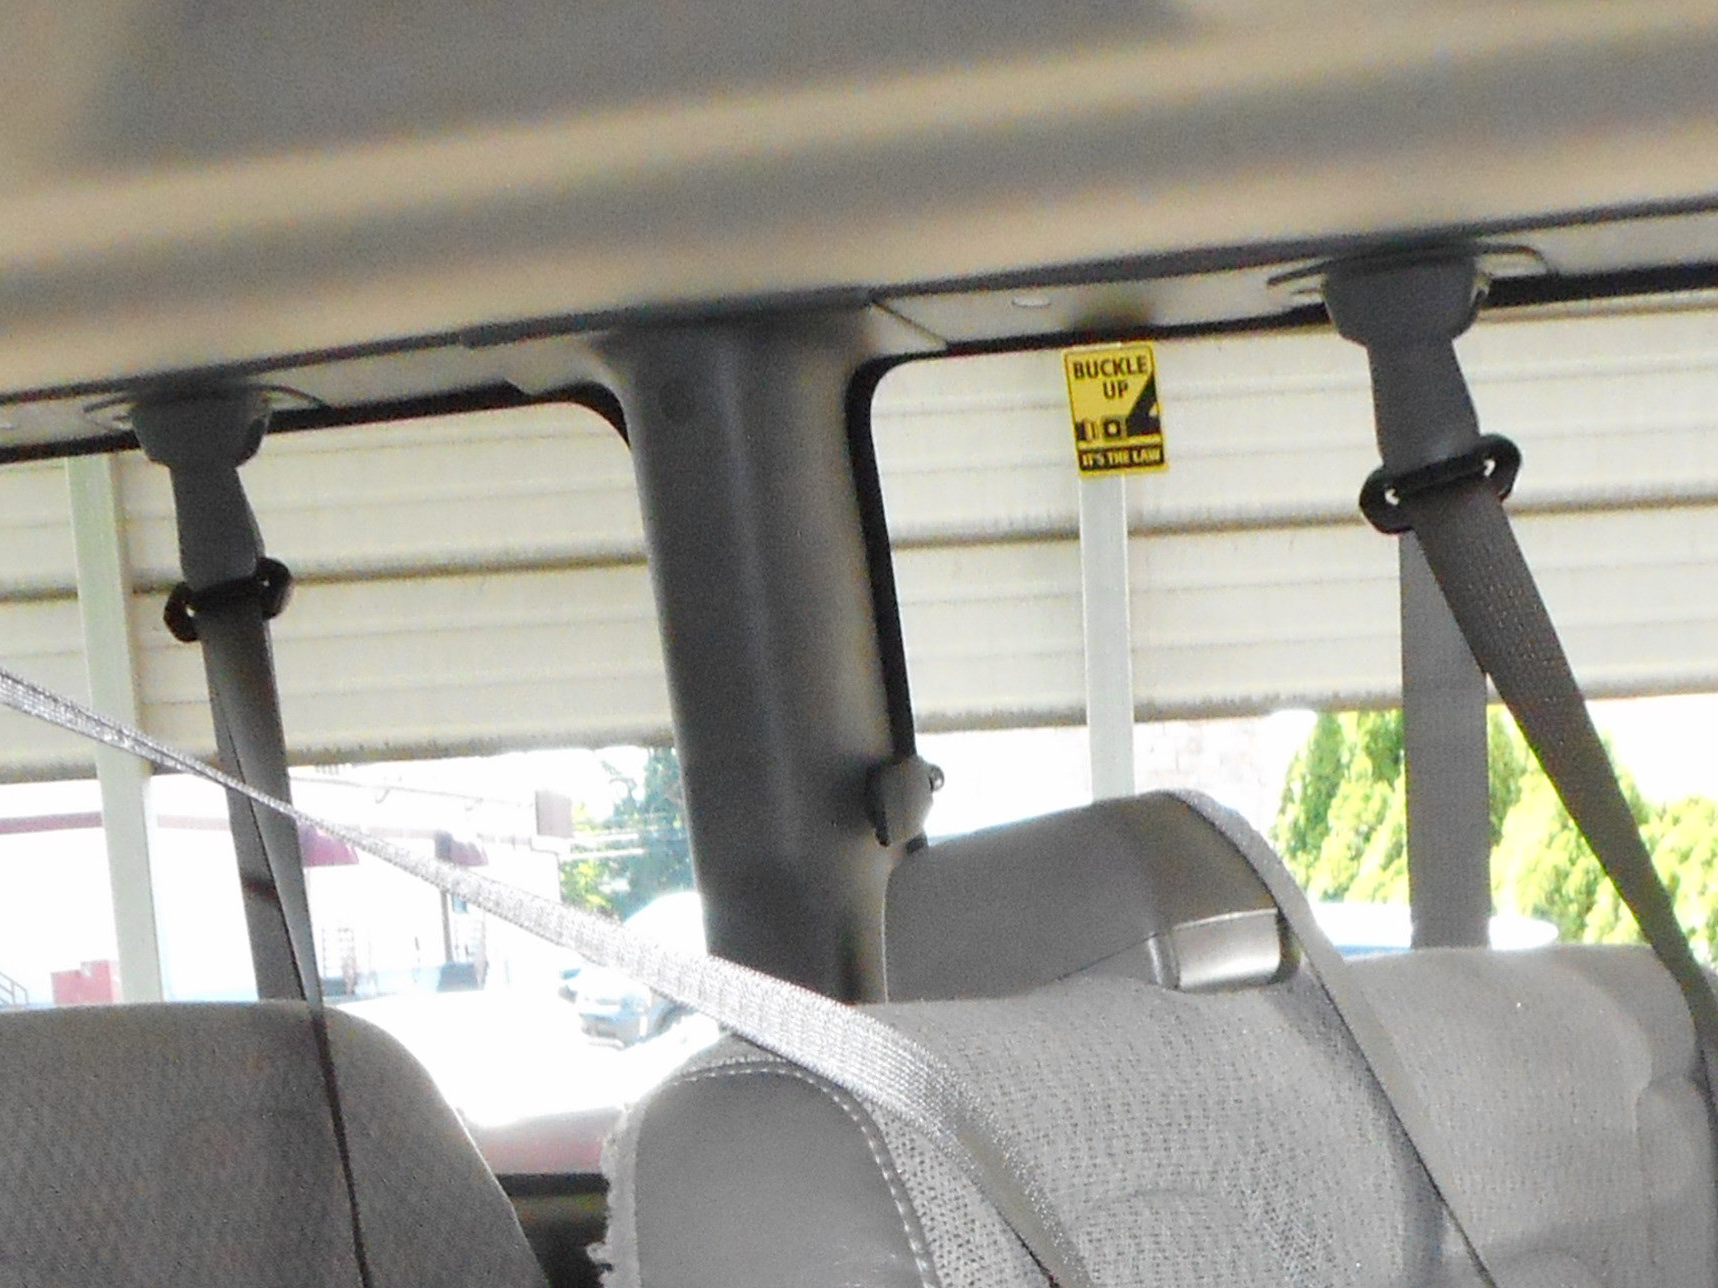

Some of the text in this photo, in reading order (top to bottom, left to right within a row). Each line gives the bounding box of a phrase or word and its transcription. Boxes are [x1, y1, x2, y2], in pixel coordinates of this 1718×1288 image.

[1073, 355, 1147, 379] BUCKLE
[1103, 380, 1129, 399] UP
[1109, 449, 1129, 466] THE
[1132, 447, 1161, 464] LAW
